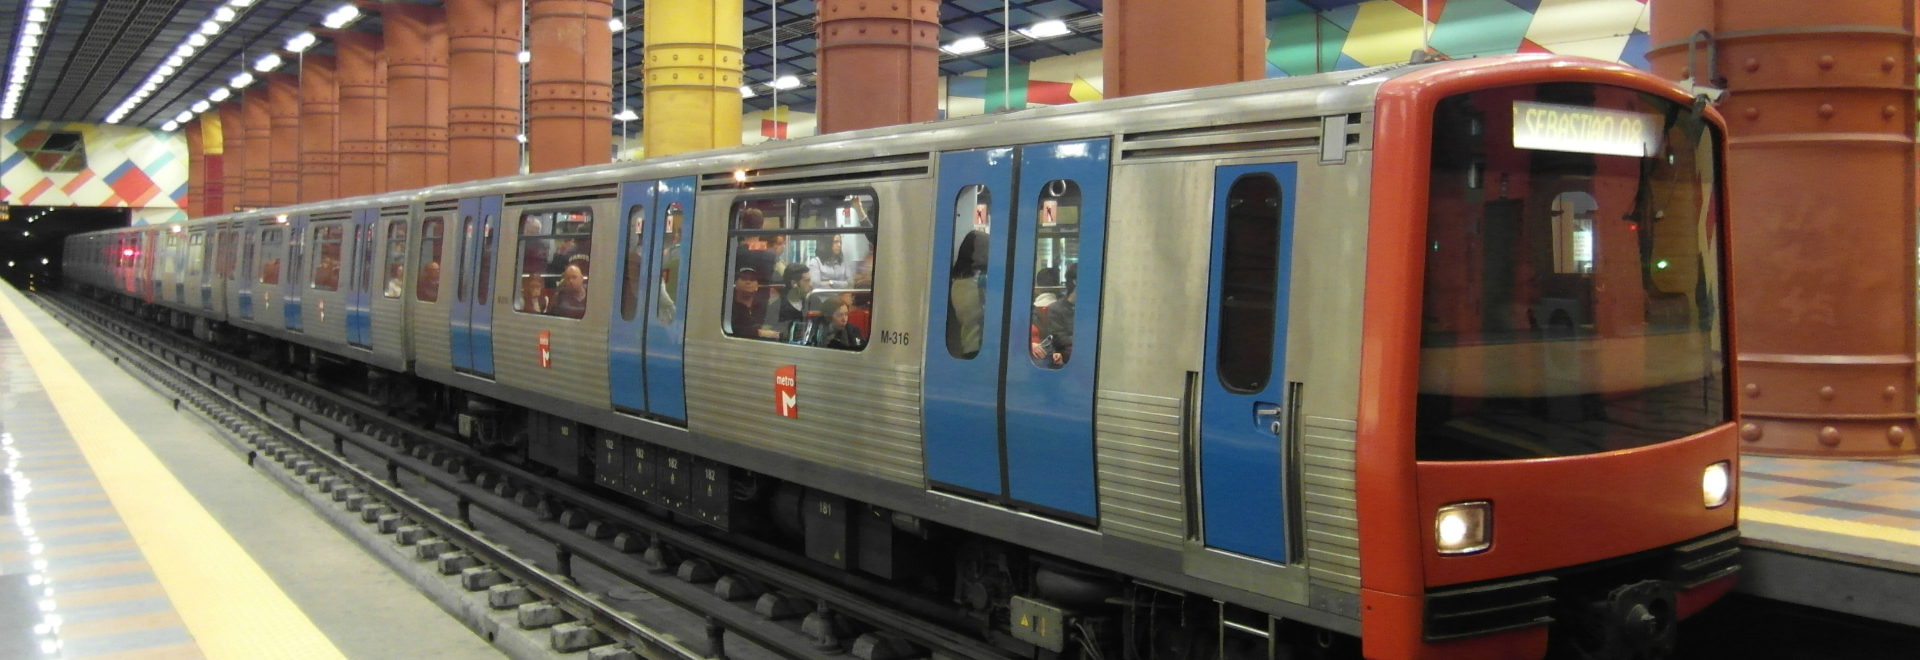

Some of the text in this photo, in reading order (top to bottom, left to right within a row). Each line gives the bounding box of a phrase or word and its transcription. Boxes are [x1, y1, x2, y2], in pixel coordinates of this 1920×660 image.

[881, 330, 910, 346] M-316
[776, 376, 795, 387] metro
[606, 439, 614, 449] 182
[636, 448, 645, 459] 182
[668, 457, 678, 469] 182
[705, 468, 716, 481] 182
[819, 501, 831, 515] 181
